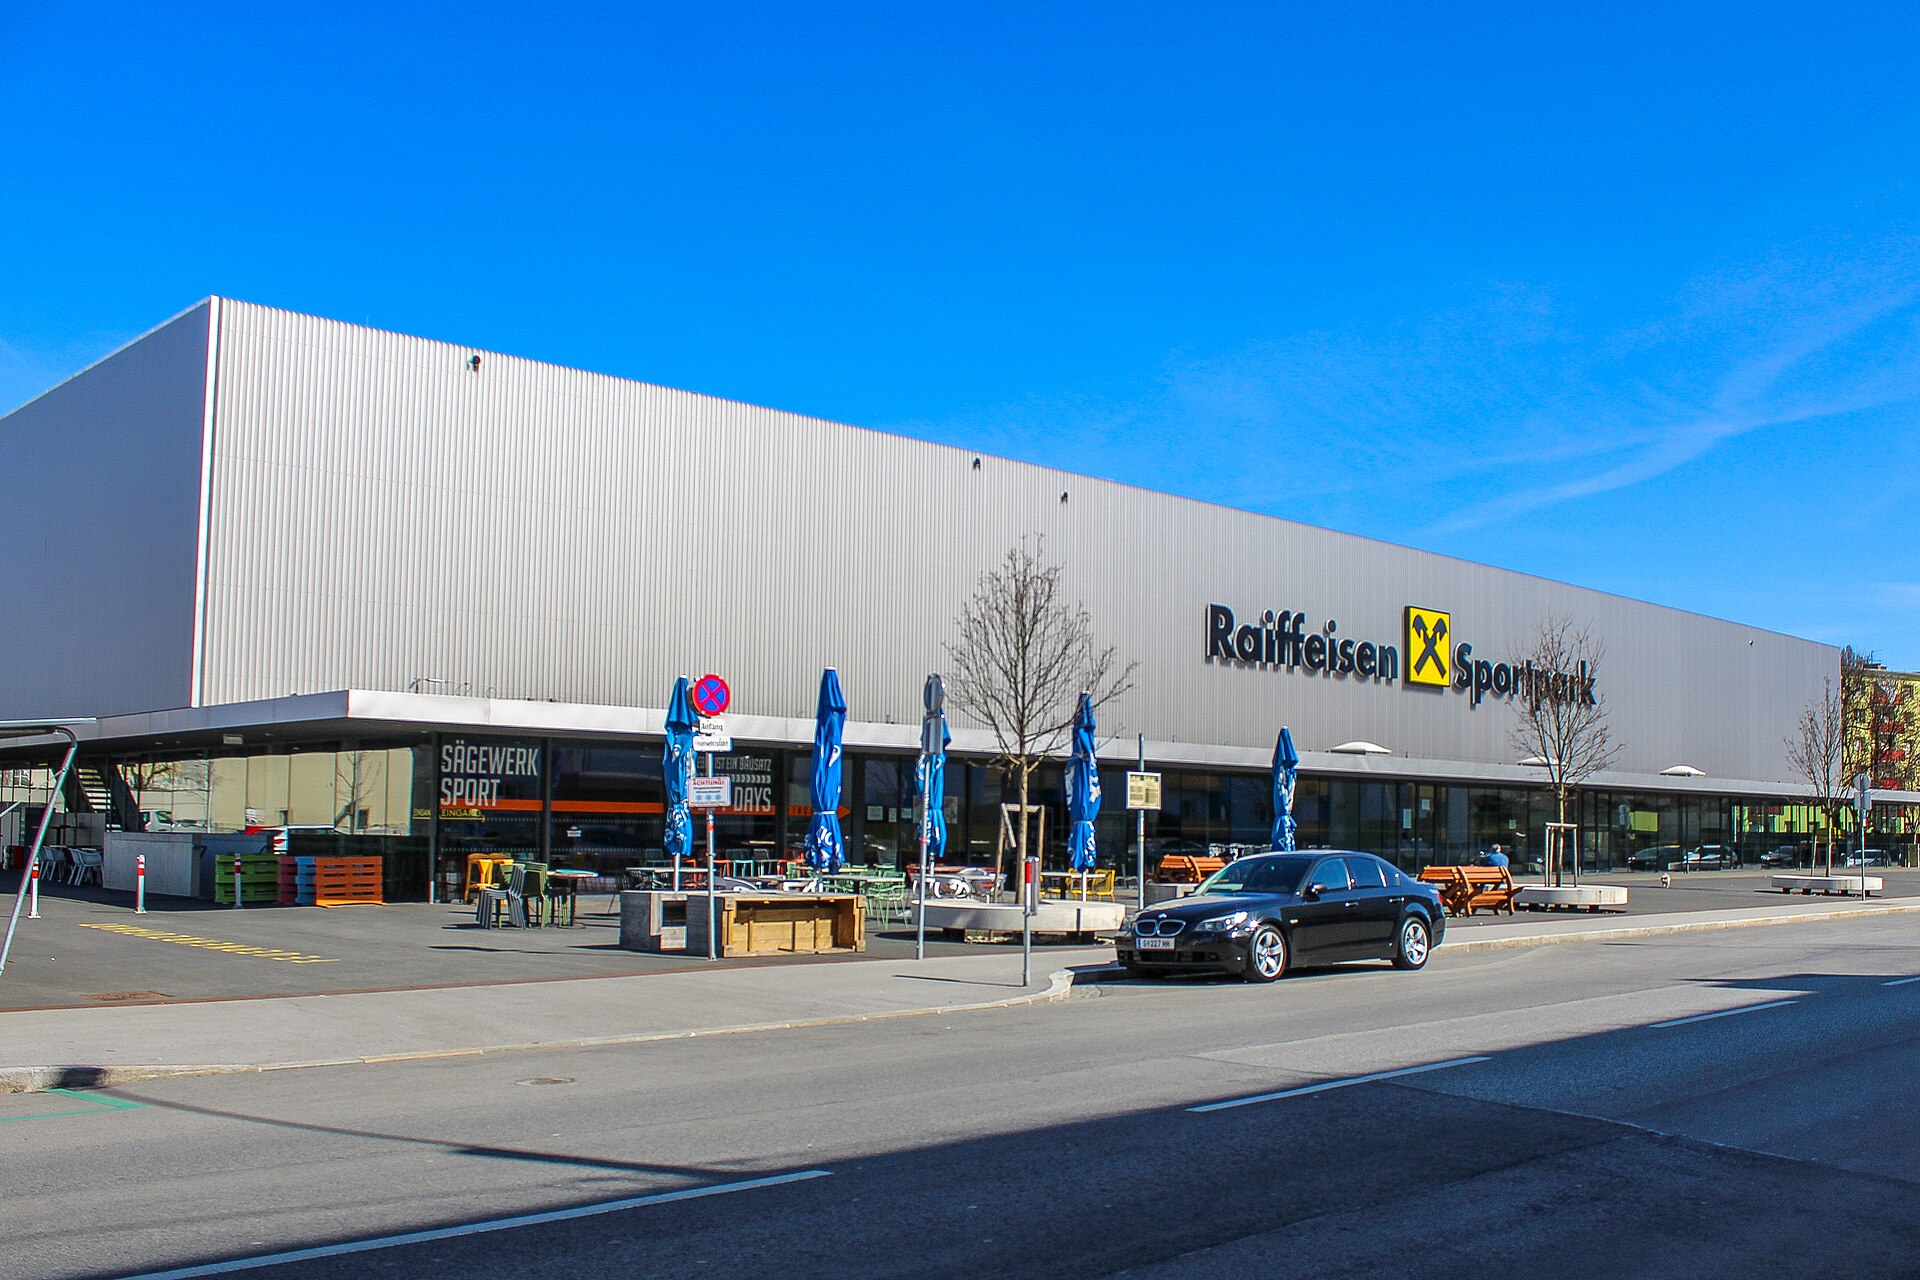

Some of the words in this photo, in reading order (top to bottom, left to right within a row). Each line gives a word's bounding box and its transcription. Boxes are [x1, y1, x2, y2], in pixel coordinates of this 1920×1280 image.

[1205, 602, 1398, 679] Raiffeisen
[1455, 642, 1597, 711] Sportpark
[701, 723, 723, 732] Anfang
[440, 739, 539, 776] SÄGEWERK
[440, 778, 500, 807] SPORT
[734, 786, 771, 812] DAYS
